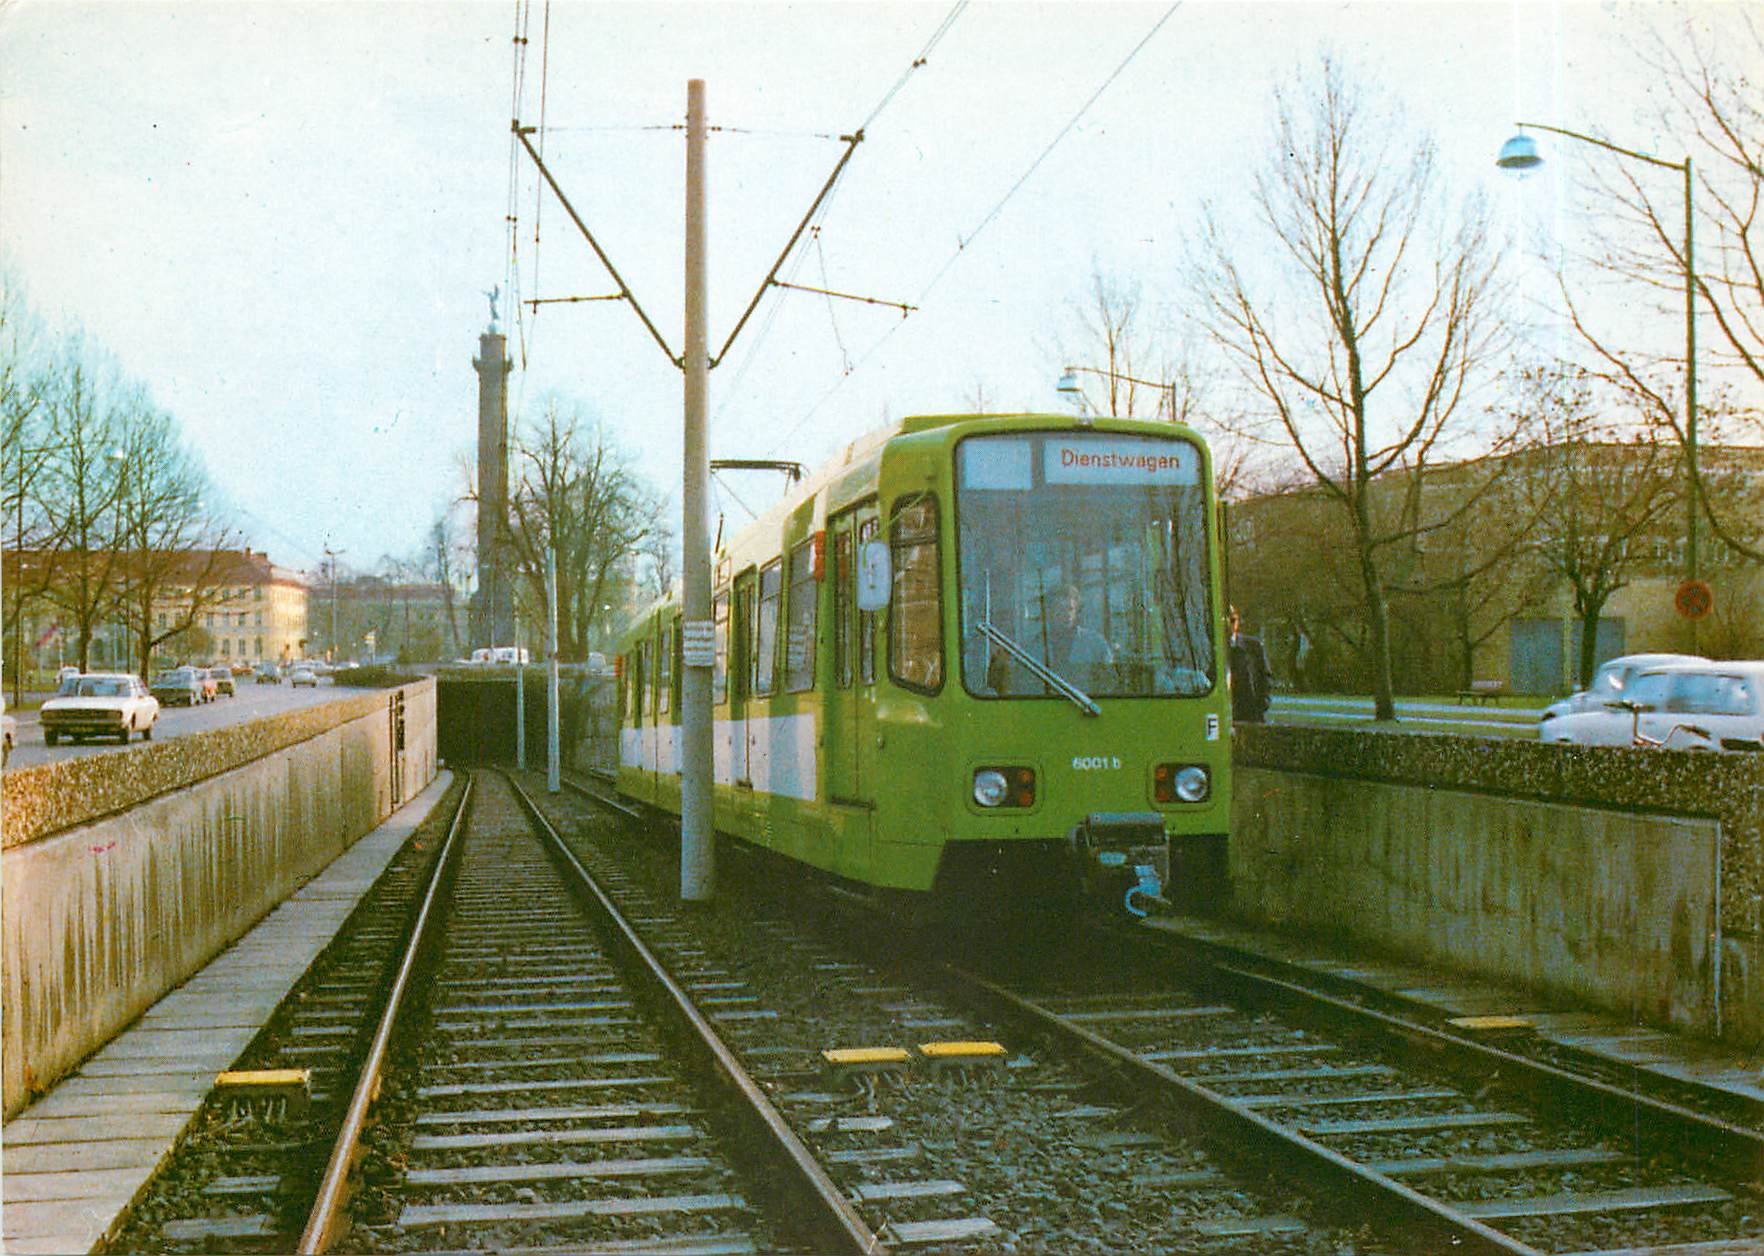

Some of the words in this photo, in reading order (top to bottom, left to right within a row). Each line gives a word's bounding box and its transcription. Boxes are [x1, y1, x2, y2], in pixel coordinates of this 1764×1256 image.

[1061, 448, 1180, 472] Dienstwagen
[1207, 718, 1217, 736] F
[1071, 756, 1108, 770] 6001
